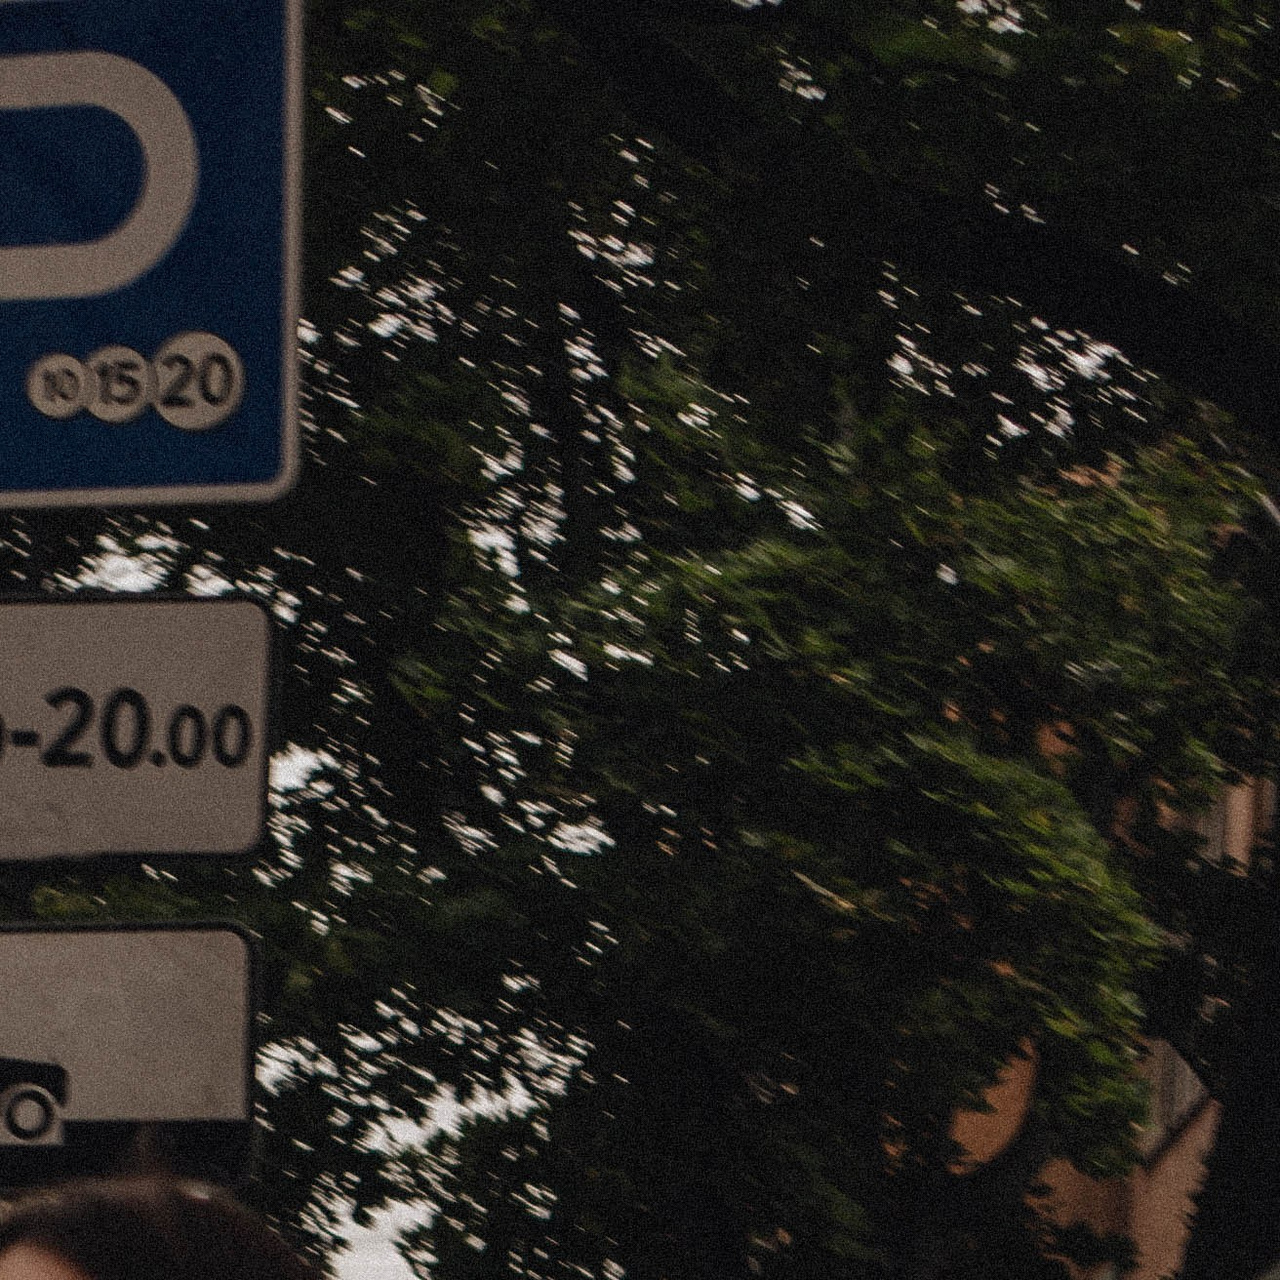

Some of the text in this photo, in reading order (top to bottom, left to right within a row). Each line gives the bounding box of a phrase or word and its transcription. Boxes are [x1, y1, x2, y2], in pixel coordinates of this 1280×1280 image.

[42, 353, 234, 408] 10 15 20
